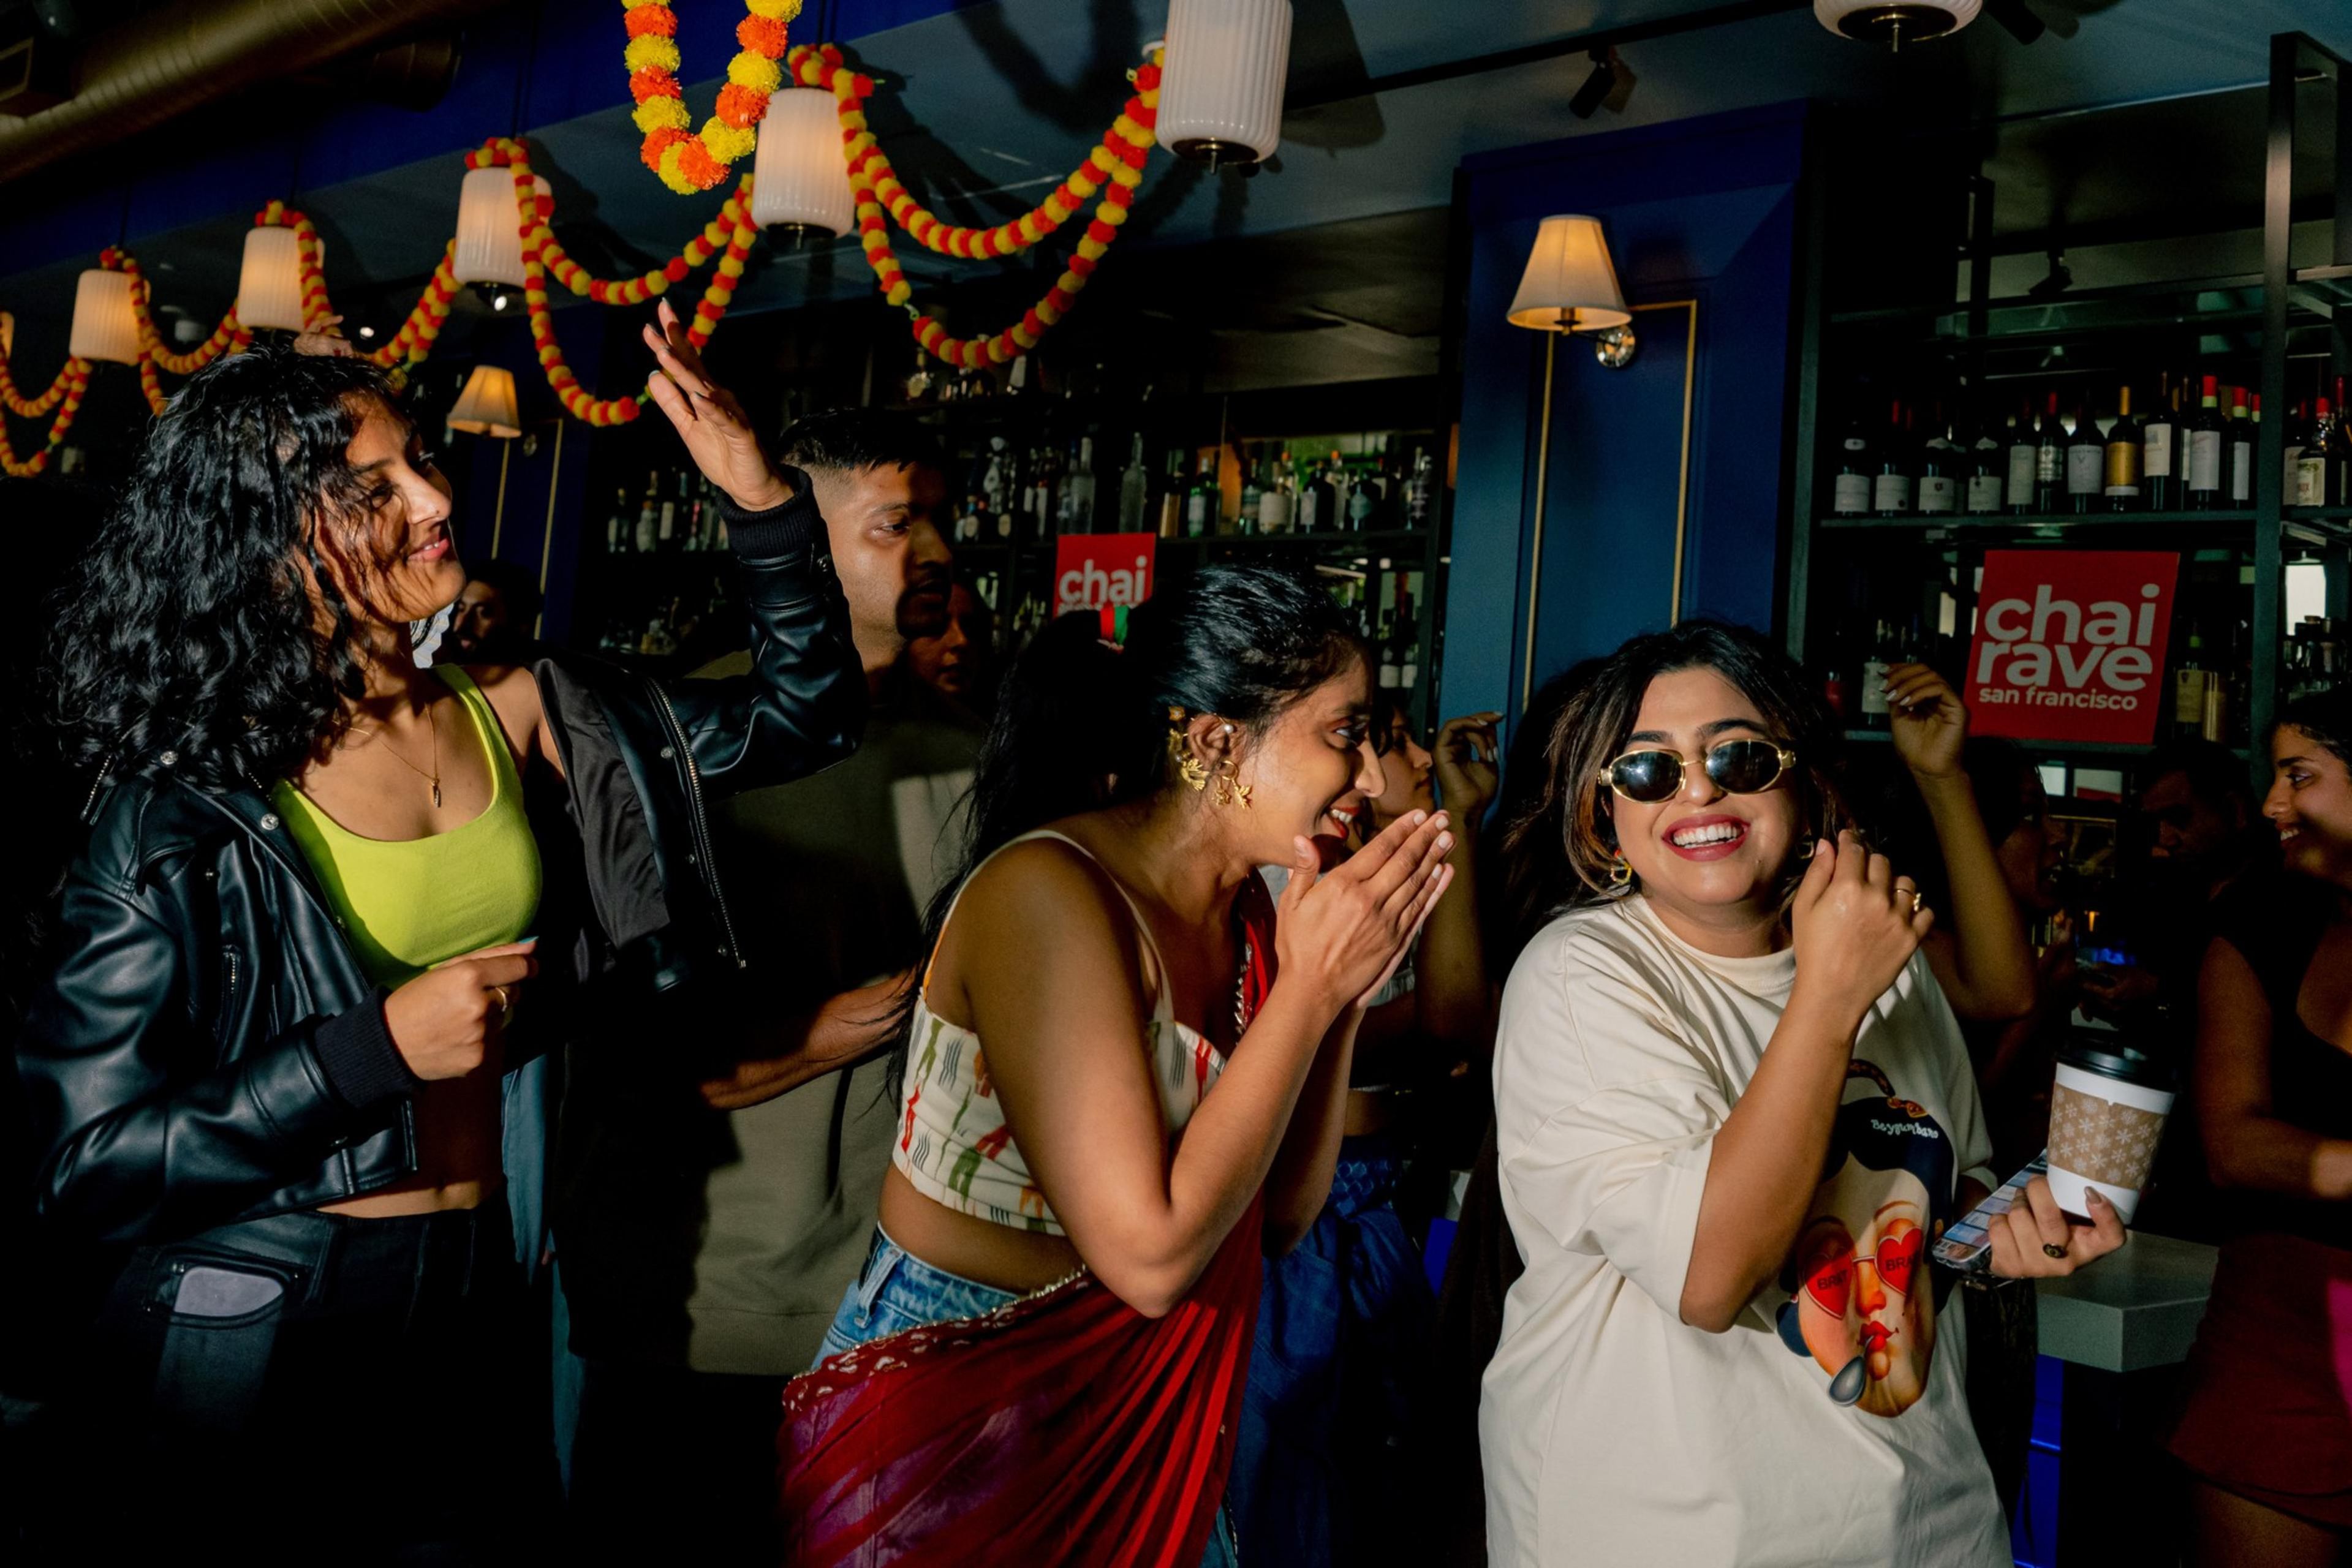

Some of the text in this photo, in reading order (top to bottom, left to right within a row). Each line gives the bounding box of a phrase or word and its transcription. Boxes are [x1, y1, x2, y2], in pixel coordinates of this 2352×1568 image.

[1059, 555, 1147, 603] chai
[1984, 583, 2160, 646] chai
[1976, 641, 2153, 692] rave
[1980, 686, 2138, 710] san francisco
